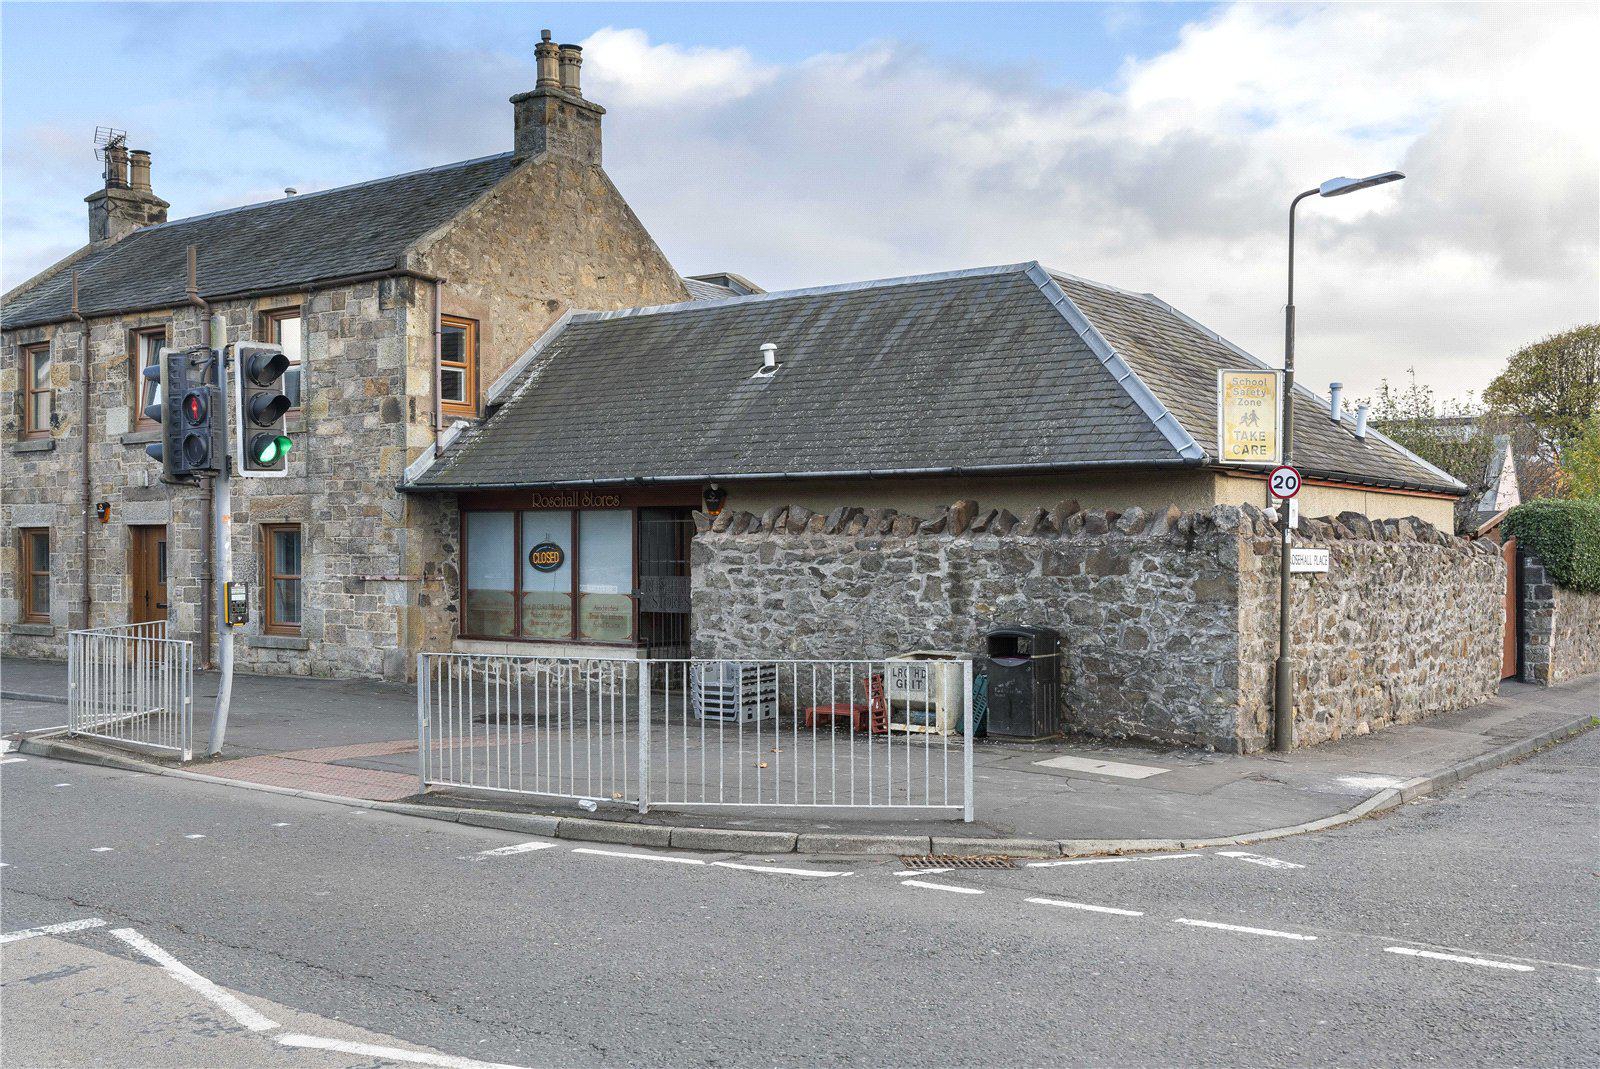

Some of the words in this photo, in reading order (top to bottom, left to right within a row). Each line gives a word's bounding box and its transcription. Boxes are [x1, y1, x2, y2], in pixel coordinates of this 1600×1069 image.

[1232, 378, 1267, 387] School
[1232, 388, 1267, 398] Safety
[1237, 398, 1262, 407] Zone
[1234, 431, 1266, 442] TAKE
[1232, 444, 1267, 456] CARE
[1273, 475, 1297, 490] 20
[532, 491, 579, 508] Rosehall
[581, 491, 620, 507] Stores
[532, 551, 560, 564] CLOSED
[1290, 554, 1312, 566] OSEHALL
[1314, 554, 1328, 566] PLACE
